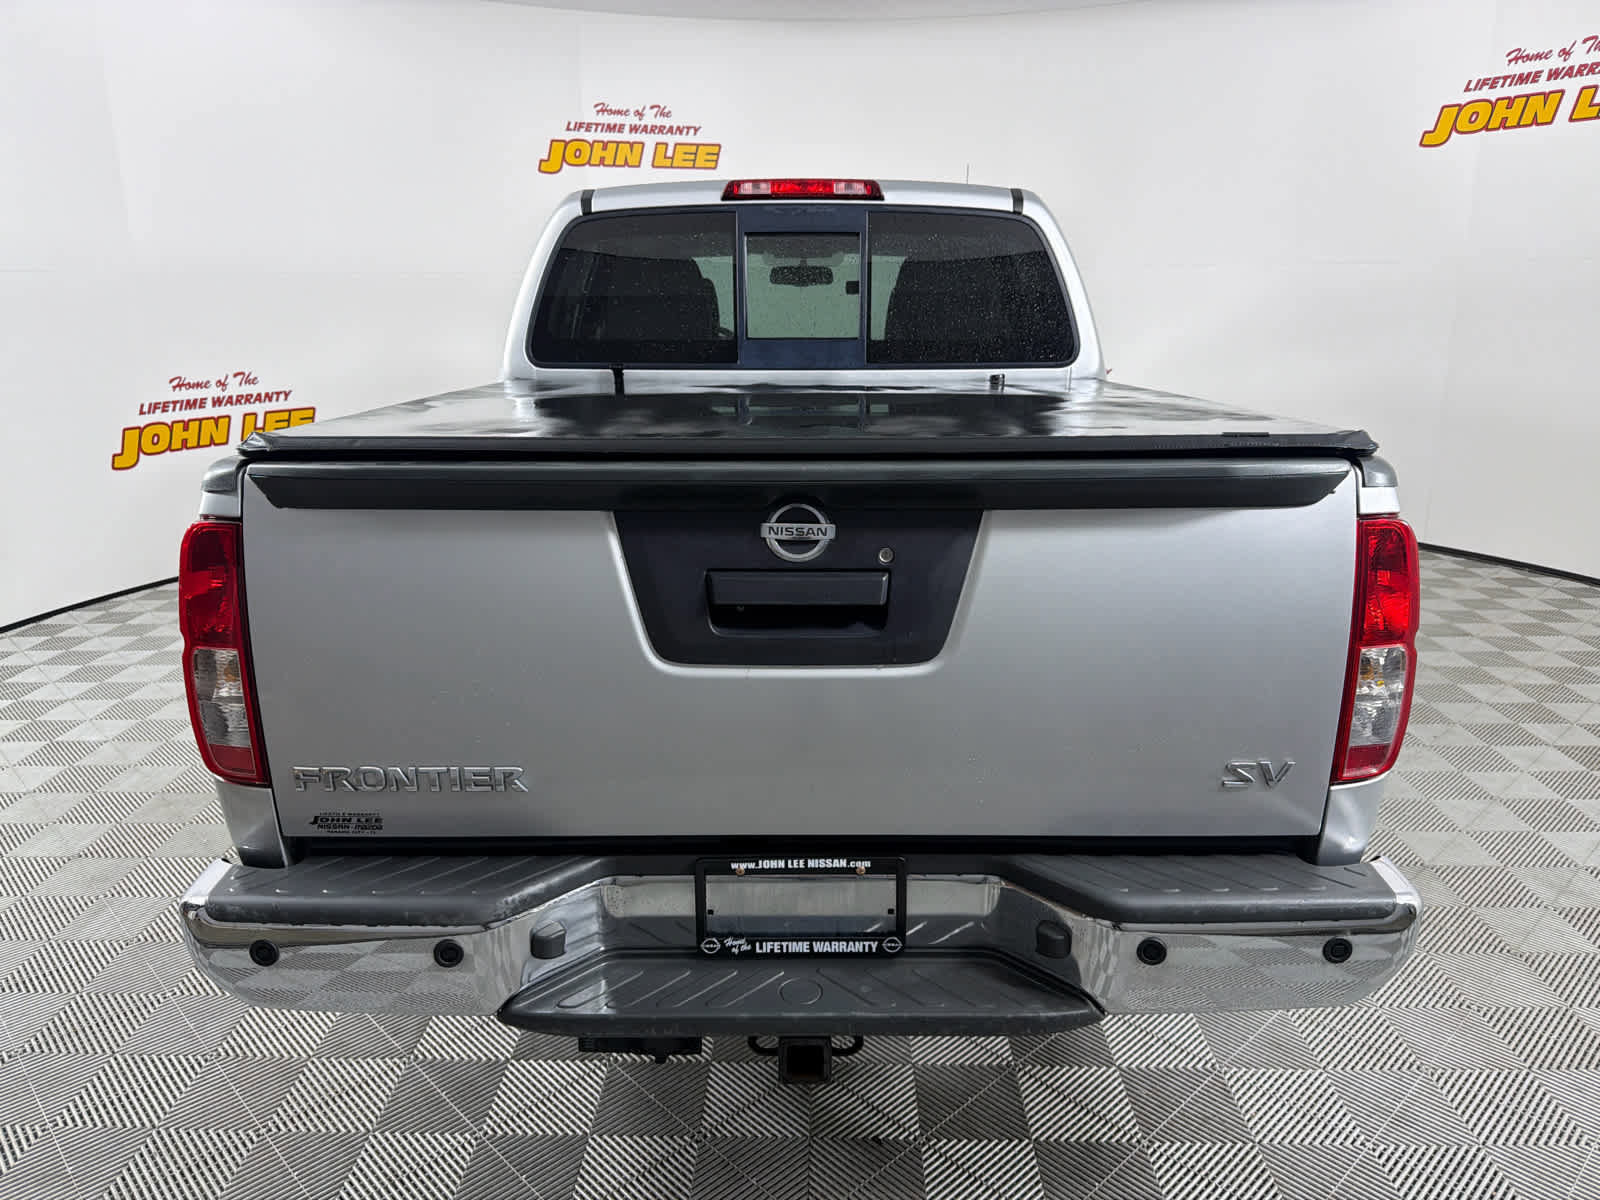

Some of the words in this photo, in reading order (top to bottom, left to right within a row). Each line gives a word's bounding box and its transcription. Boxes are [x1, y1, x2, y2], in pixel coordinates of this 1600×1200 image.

[1506, 48, 1553, 66] Home
[1557, 40, 1577, 62] of
[1463, 70, 1544, 93] LIFETIME
[593, 102, 631, 117] Home
[633, 106, 645, 121] of
[649, 104, 672, 119] The
[1419, 89, 1565, 147] JOHN
[1568, 85, 1600, 123] L
[565, 121, 625, 134] LIFETIME
[628, 123, 702, 136] WARRANTY
[538, 138, 645, 174] JOHN
[651, 141, 721, 170] LEE
[169, 376, 211, 393] Home
[215, 374, 229, 392] of
[233, 371, 259, 387] The
[139, 397, 208, 416] LIFETIME
[211, 390, 293, 408] WARRANTY
[112, 415, 231, 470] JOHN
[767, 526, 828, 537] NISSAN
[291, 765, 529, 792] FRONTIER
[1221, 759, 1297, 791] SV
[308, 816, 352, 825] JOHN
[730, 859, 785, 870] www.JOHN
[788, 859, 806, 869] LEE
[755, 941, 811, 953] LIFETIME
[812, 941, 879, 953] WARRANTY
